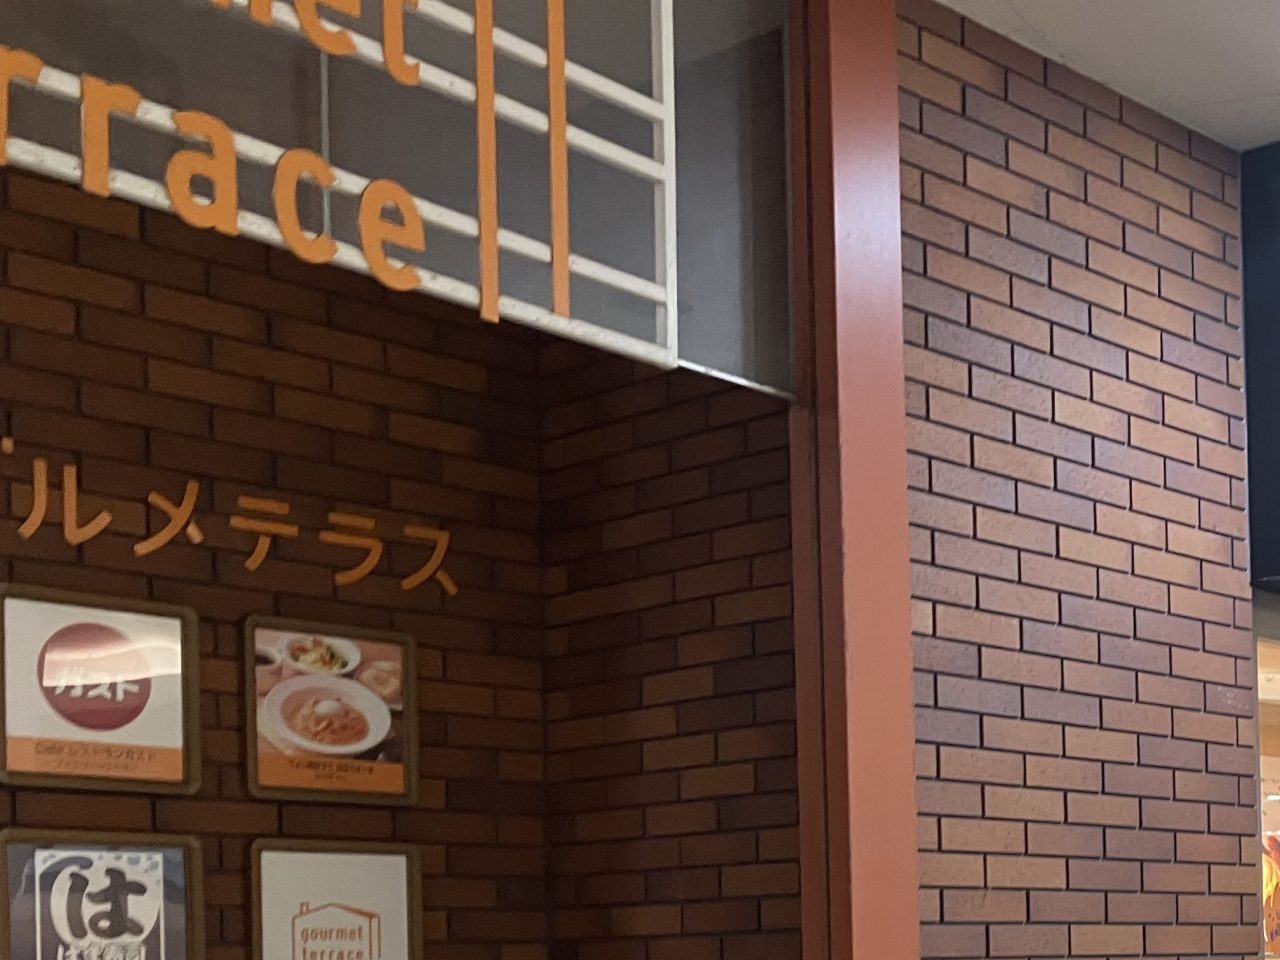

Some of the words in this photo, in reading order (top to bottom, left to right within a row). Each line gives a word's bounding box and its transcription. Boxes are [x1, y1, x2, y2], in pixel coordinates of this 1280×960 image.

[0, 437, 459, 596] ルメテラス
[66, 867, 147, 939] は
[301, 925, 363, 945] gourmet
